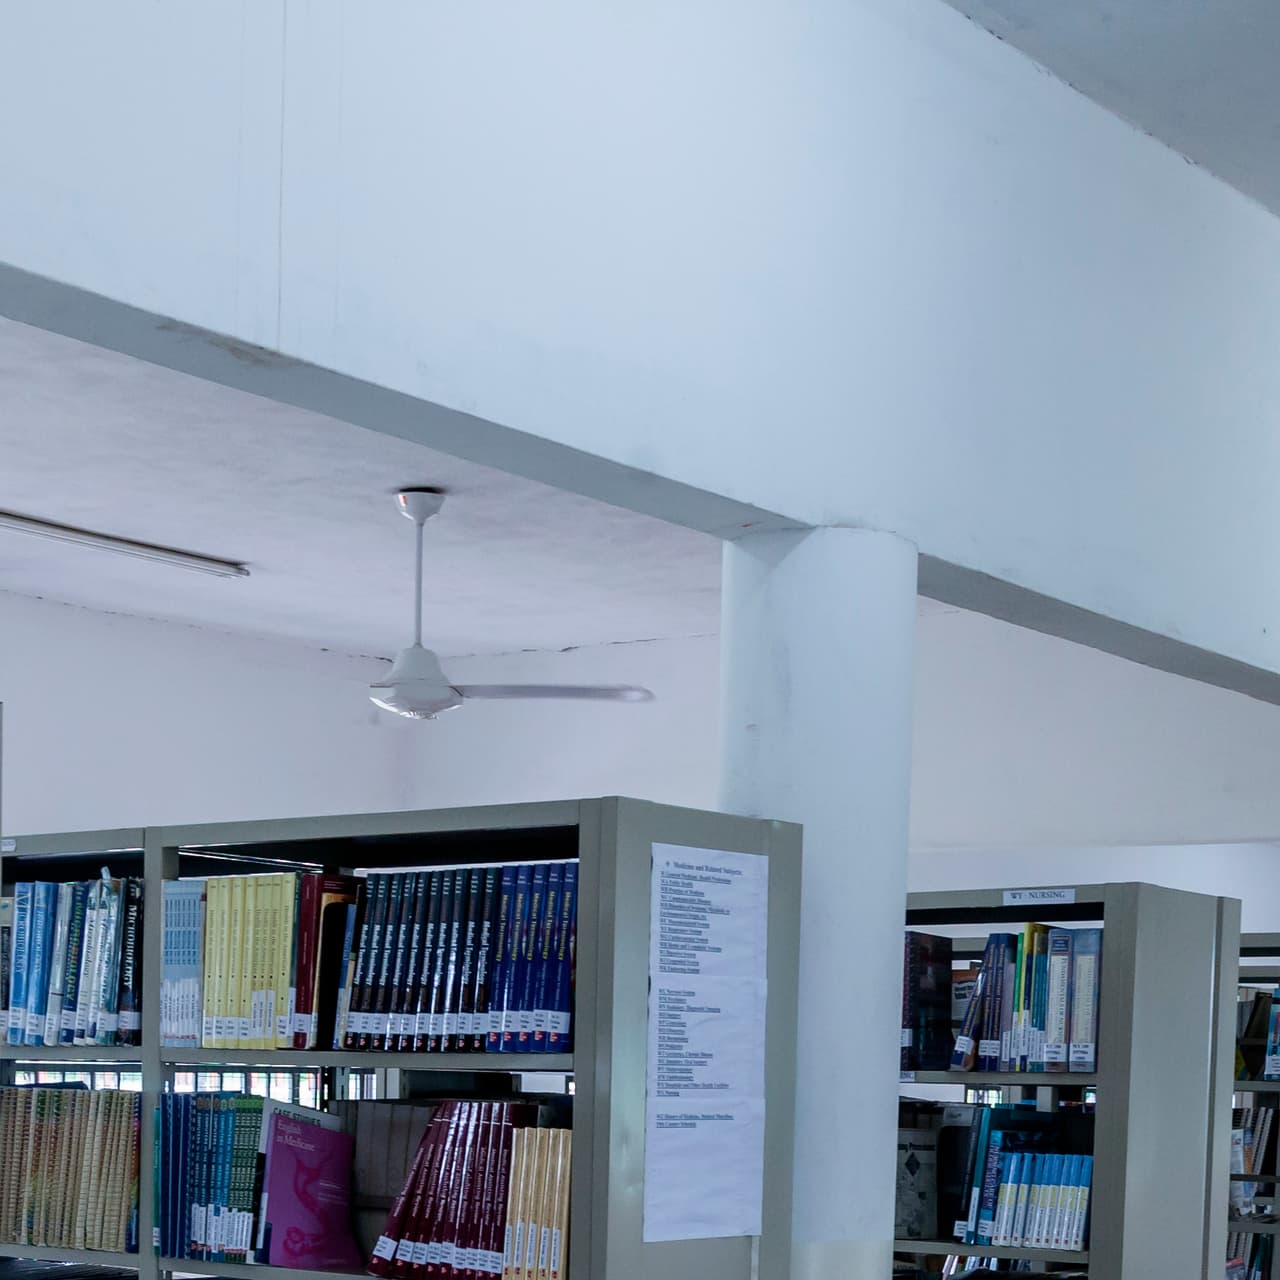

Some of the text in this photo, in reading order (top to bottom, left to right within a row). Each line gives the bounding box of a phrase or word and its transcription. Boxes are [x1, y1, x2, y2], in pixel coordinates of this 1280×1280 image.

[1028, 890, 1064, 899] NURSING
[123, 905, 137, 987] MICROBIOLOGY
[277, 1120, 302, 1134] English
[285, 1136, 315, 1151] Medicine
